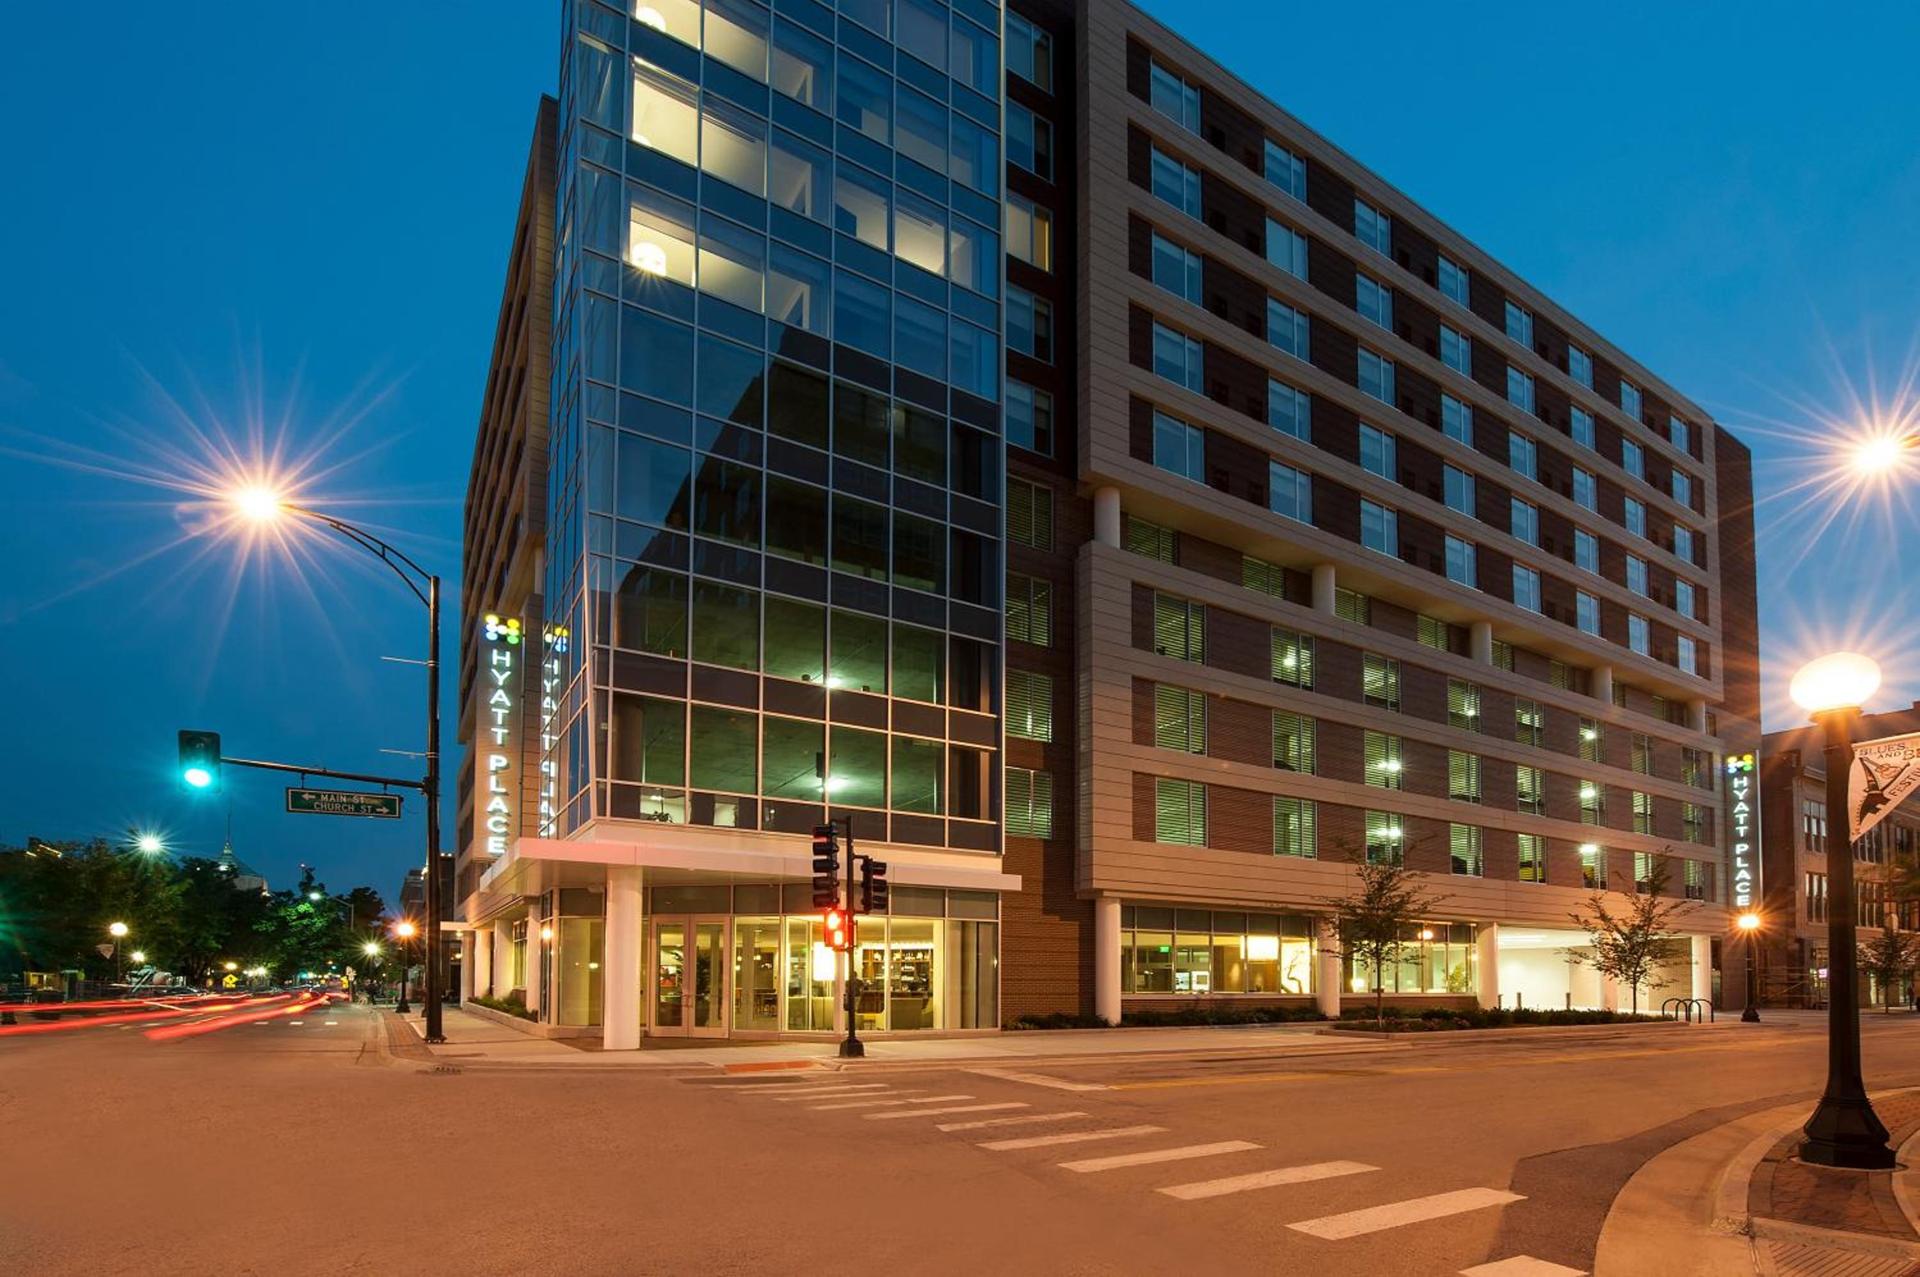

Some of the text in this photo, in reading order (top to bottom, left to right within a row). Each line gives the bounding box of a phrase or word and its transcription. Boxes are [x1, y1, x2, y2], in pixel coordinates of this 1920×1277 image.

[487, 648, 511, 855] HYATT PLACE
[1878, 750, 1902, 759] AND
[320, 793, 365, 804] MAIN ST
[313, 801, 372, 814] CHURCH ST
[1733, 776, 1751, 907] HYATT PLACE
